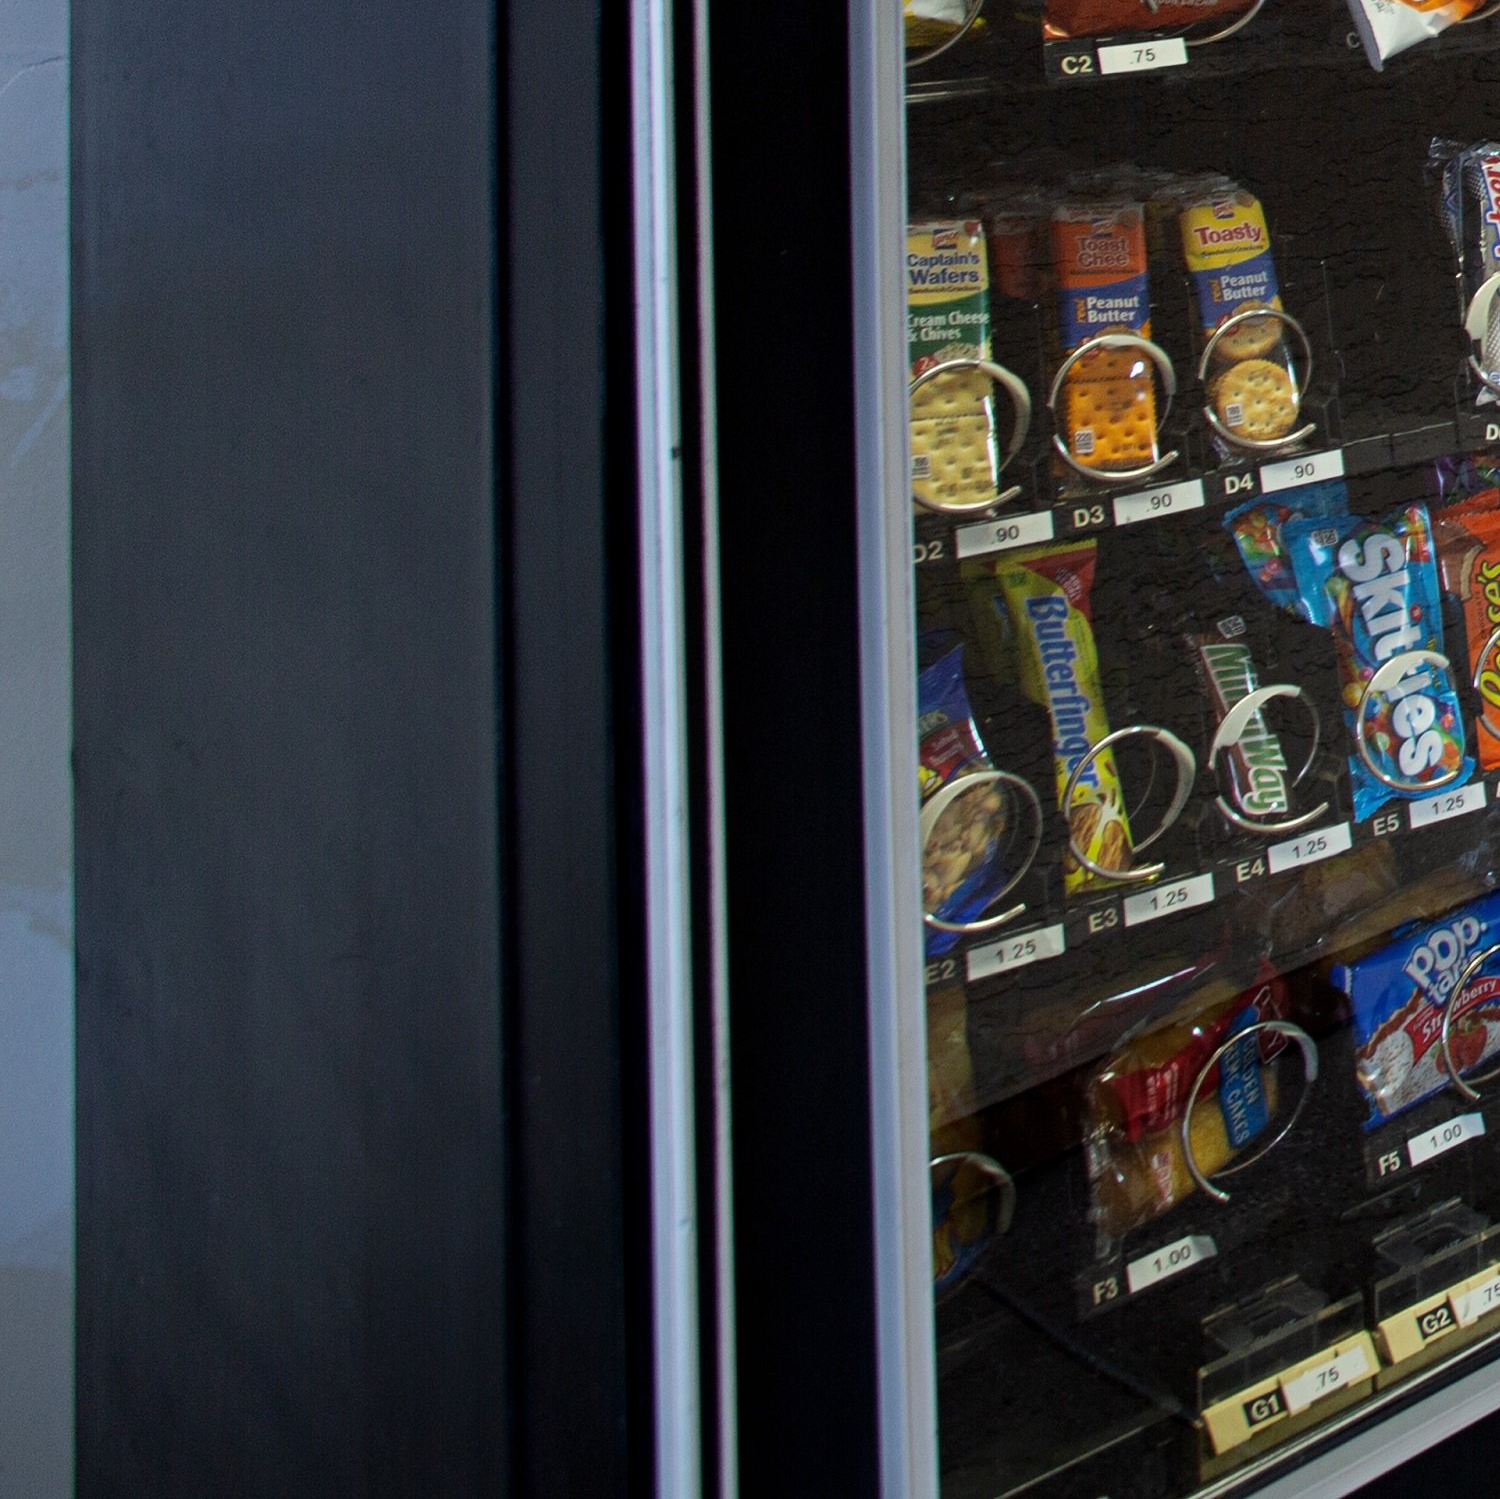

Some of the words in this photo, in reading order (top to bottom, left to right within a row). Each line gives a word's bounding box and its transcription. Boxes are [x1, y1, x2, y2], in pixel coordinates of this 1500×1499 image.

[1061, 56, 1094, 75] C2
[1130, 48, 1156, 65] .75
[1077, 236, 1128, 254] Toast
[1193, 222, 1263, 247] Toasty
[907, 252, 981, 269] Captain's
[1077, 251, 1128, 268] Chee
[909, 269, 981, 285] Wafers
[1220, 270, 1269, 287] Peanut
[1086, 295, 1140, 310] Peanut
[1222, 284, 1266, 301] Butter
[906, 313, 947, 328] Cream
[948, 310, 990, 325] Cheese
[1086, 308, 1137, 323] Butter
[920, 327, 962, 342] Chives
[1224, 471, 1254, 495] D4
[1073, 506, 1105, 529] D3
[912, 540, 944, 564] D2
[1025, 596, 1099, 791] Butterfinger
[1432, 795, 1465, 815] 1.25
[1373, 816, 1400, 837] E5
[1293, 838, 1328, 859] 1.25
[1236, 861, 1265, 883] E4
[1150, 889, 1189, 911] 1.25
[1088, 911, 1119, 933] E3
[996, 940, 1037, 964] 1.25
[925, 963, 955, 986] E2
[1421, 978, 1498, 1044] Strberry
[1240, 1031, 1262, 1107] GOLDEN
[1225, 1087, 1252, 1146] CAKES
[1430, 1124, 1463, 1149] 1.00
[1377, 1150, 1401, 1177] F5
[1153, 1245, 1192, 1273] 1.00
[1092, 1279, 1119, 1305] F3
[1421, 1306, 1452, 1335] G2
[1315, 1367, 1341, 1392] .75
[1249, 1393, 1280, 1422] G1
